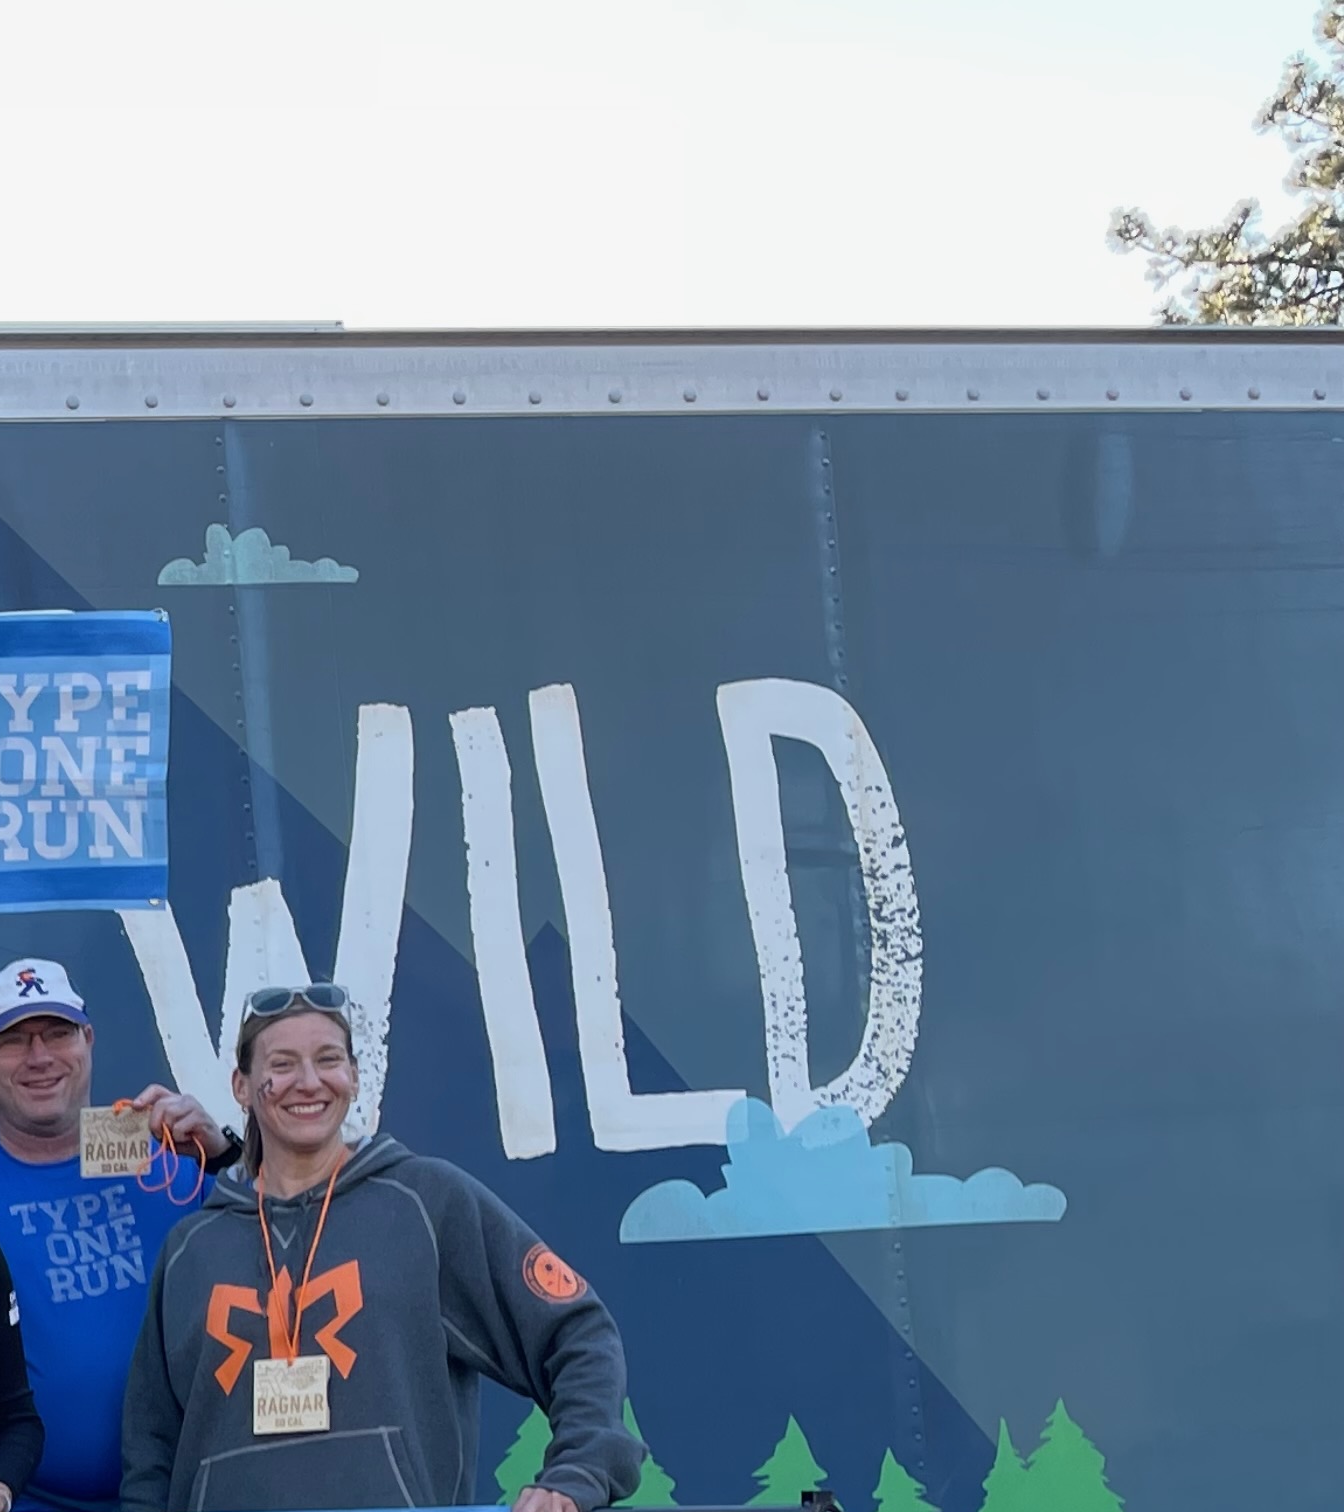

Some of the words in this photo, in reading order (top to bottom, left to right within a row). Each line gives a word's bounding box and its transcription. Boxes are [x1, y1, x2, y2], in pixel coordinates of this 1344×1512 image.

[115, 677, 924, 1160] WILD
[85, 1141, 149, 1161] RAGNAR
[9, 1184, 133, 1236] TYPE
[45, 1213, 142, 1266] ONE
[45, 1249, 147, 1303] RUN
[257, 1393, 324, 1416] RAGNAR
